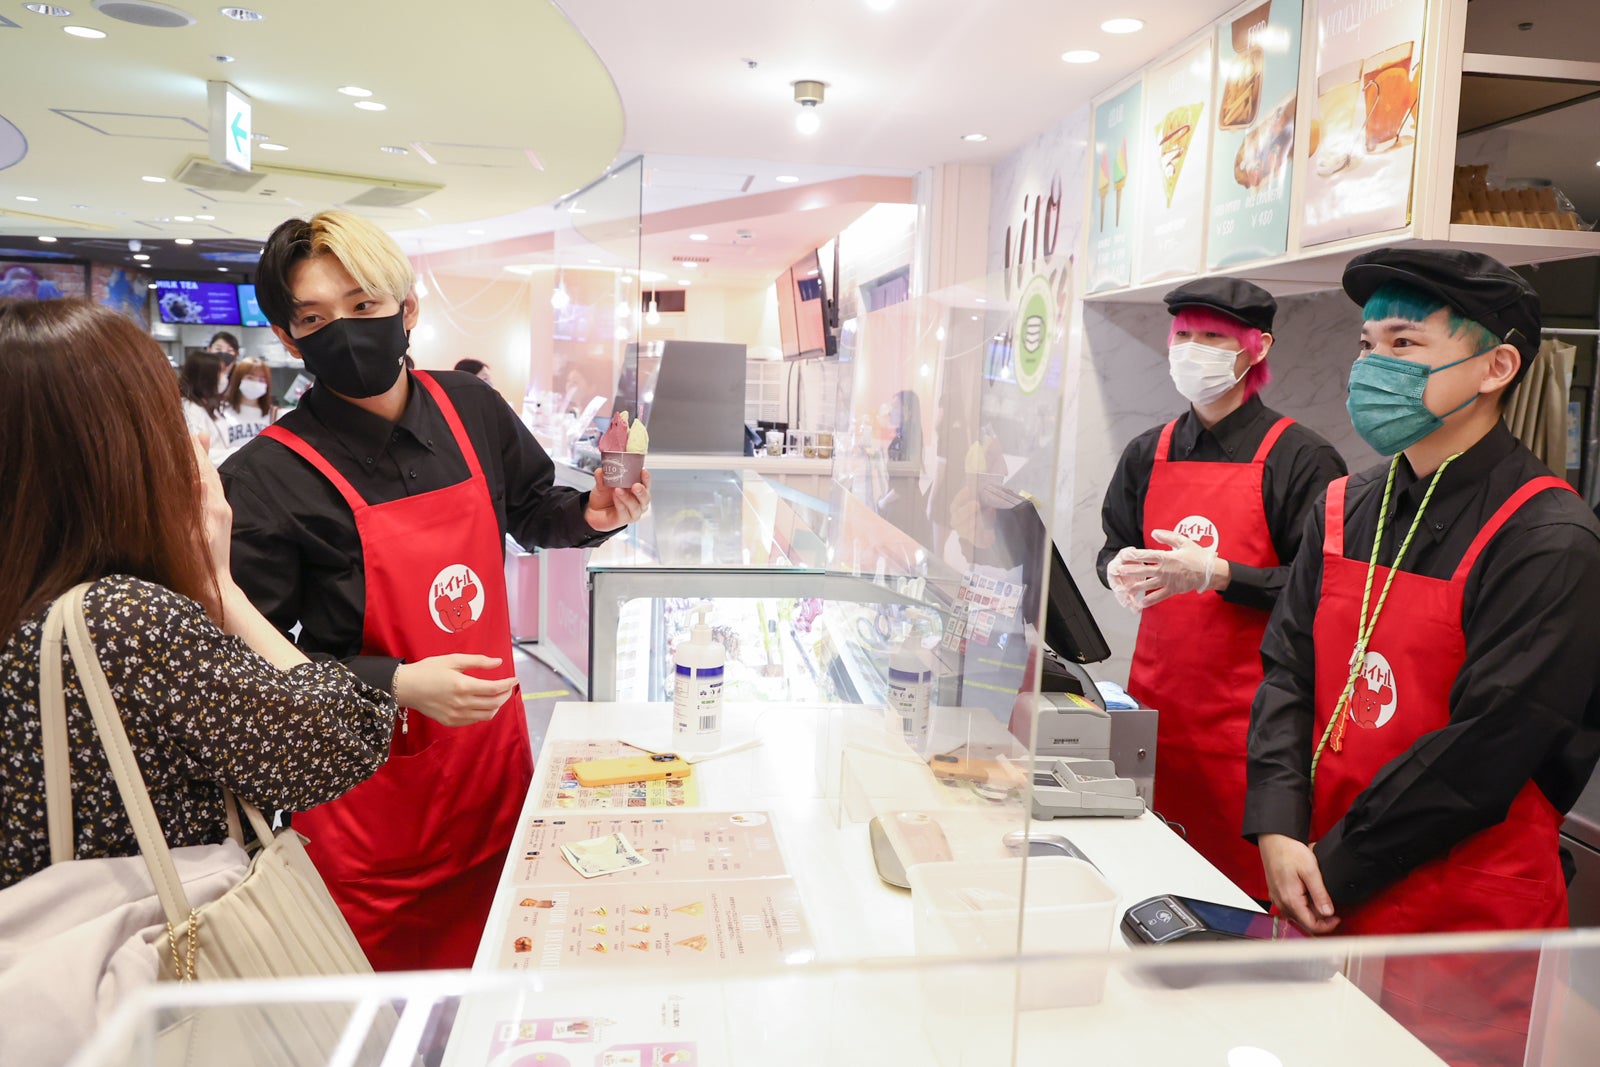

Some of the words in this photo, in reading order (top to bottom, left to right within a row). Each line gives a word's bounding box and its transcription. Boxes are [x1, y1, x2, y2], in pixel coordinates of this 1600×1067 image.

[155, 280, 178, 289] MILK
[179, 281, 199, 290] TEA
[1178, 523, 1213, 536] バイトル
[434, 568, 473, 598] バイトル
